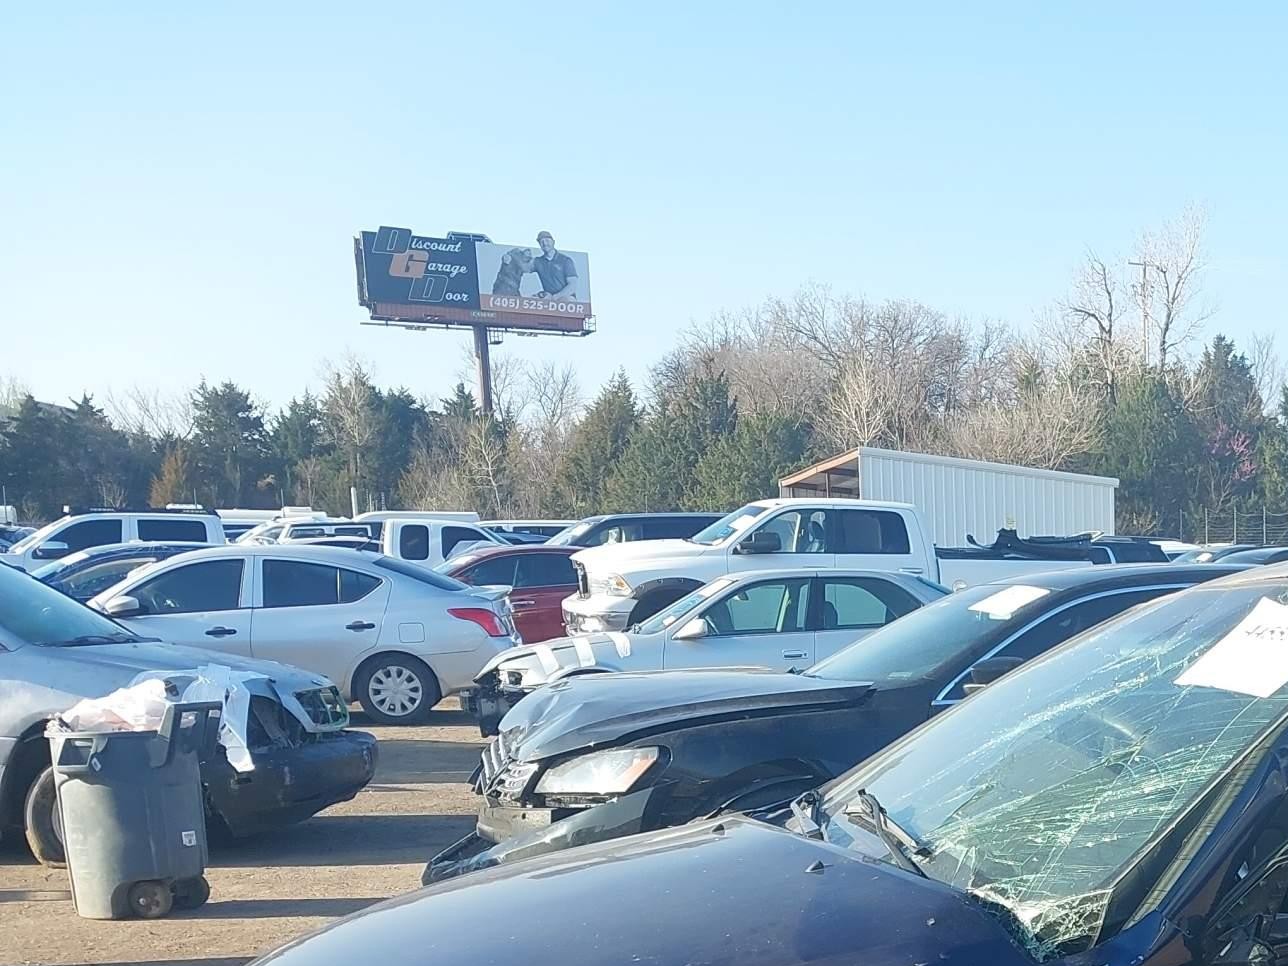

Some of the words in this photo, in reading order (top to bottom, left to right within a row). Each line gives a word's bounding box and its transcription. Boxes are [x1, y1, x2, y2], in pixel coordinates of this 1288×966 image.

[372, 226, 462, 254] Discount
[389, 250, 468, 278] Garage
[408, 274, 470, 302] Door
[489, 297, 520, 310] (405)
[523, 299, 585, 314] 525-DOOR
